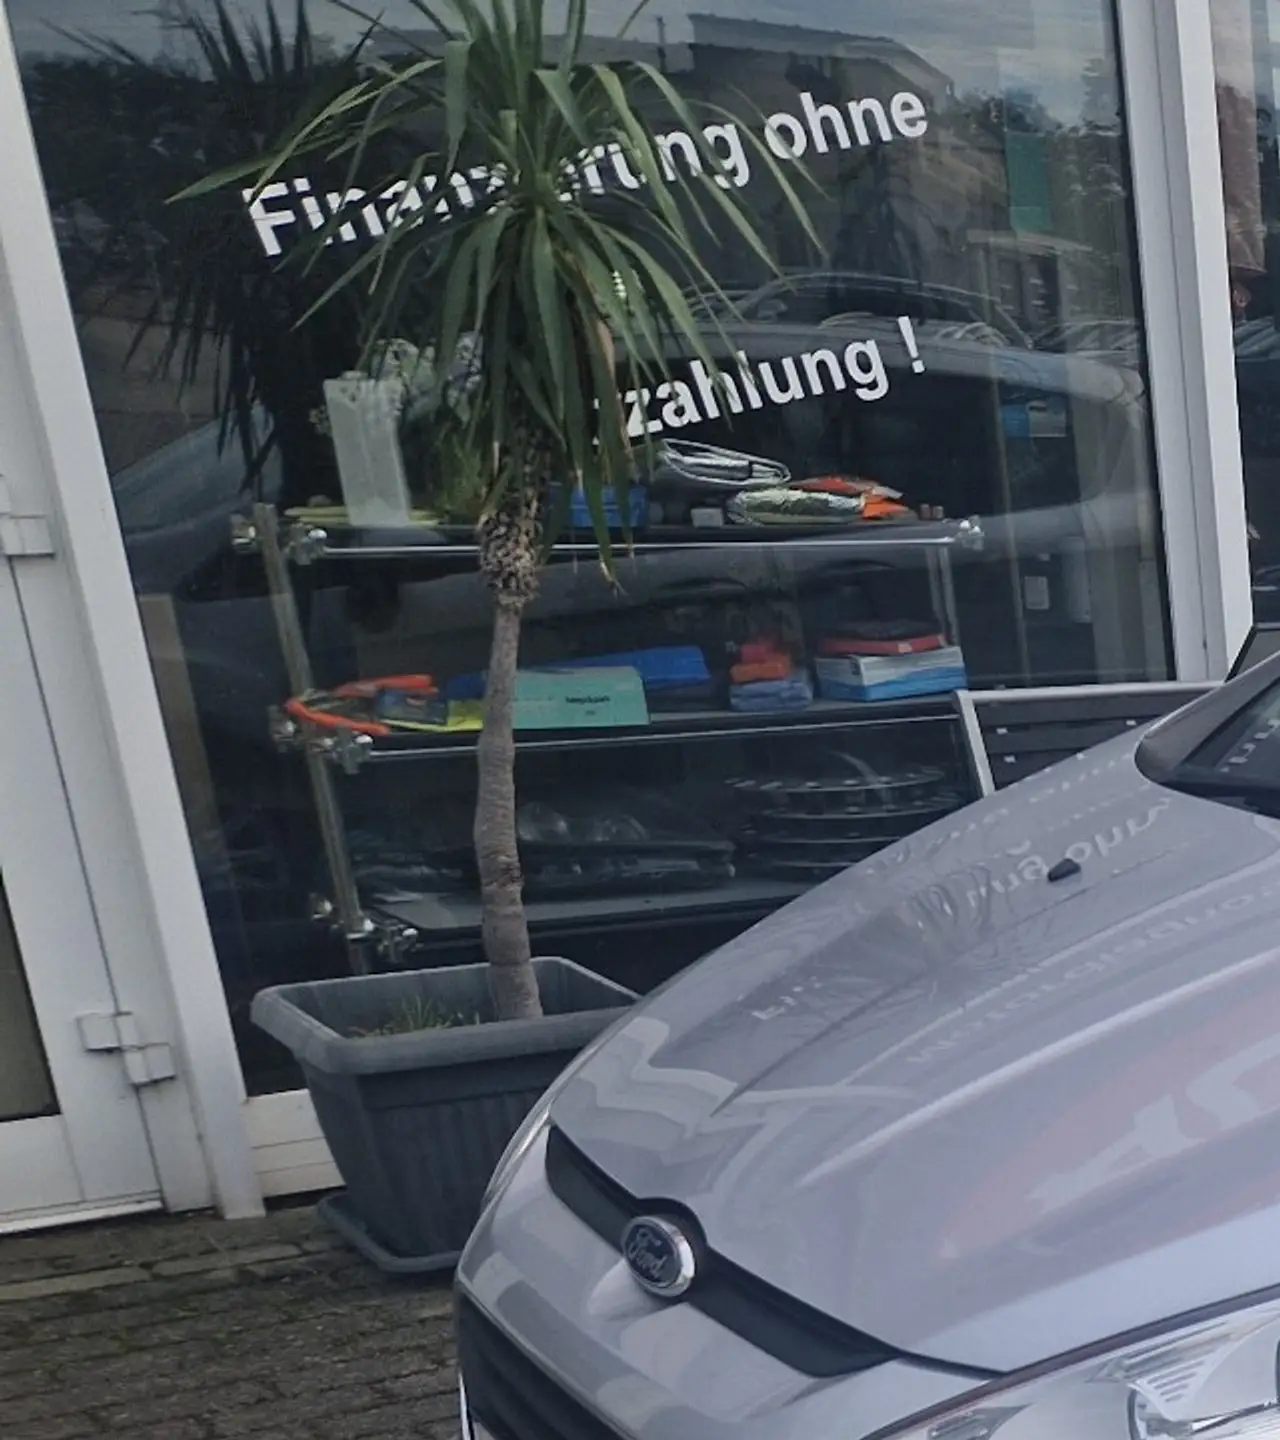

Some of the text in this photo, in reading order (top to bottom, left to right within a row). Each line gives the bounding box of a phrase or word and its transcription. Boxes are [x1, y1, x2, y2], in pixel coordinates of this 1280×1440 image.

[764, 90, 929, 160] ohne
[594, 315, 926, 440] zahlung !
